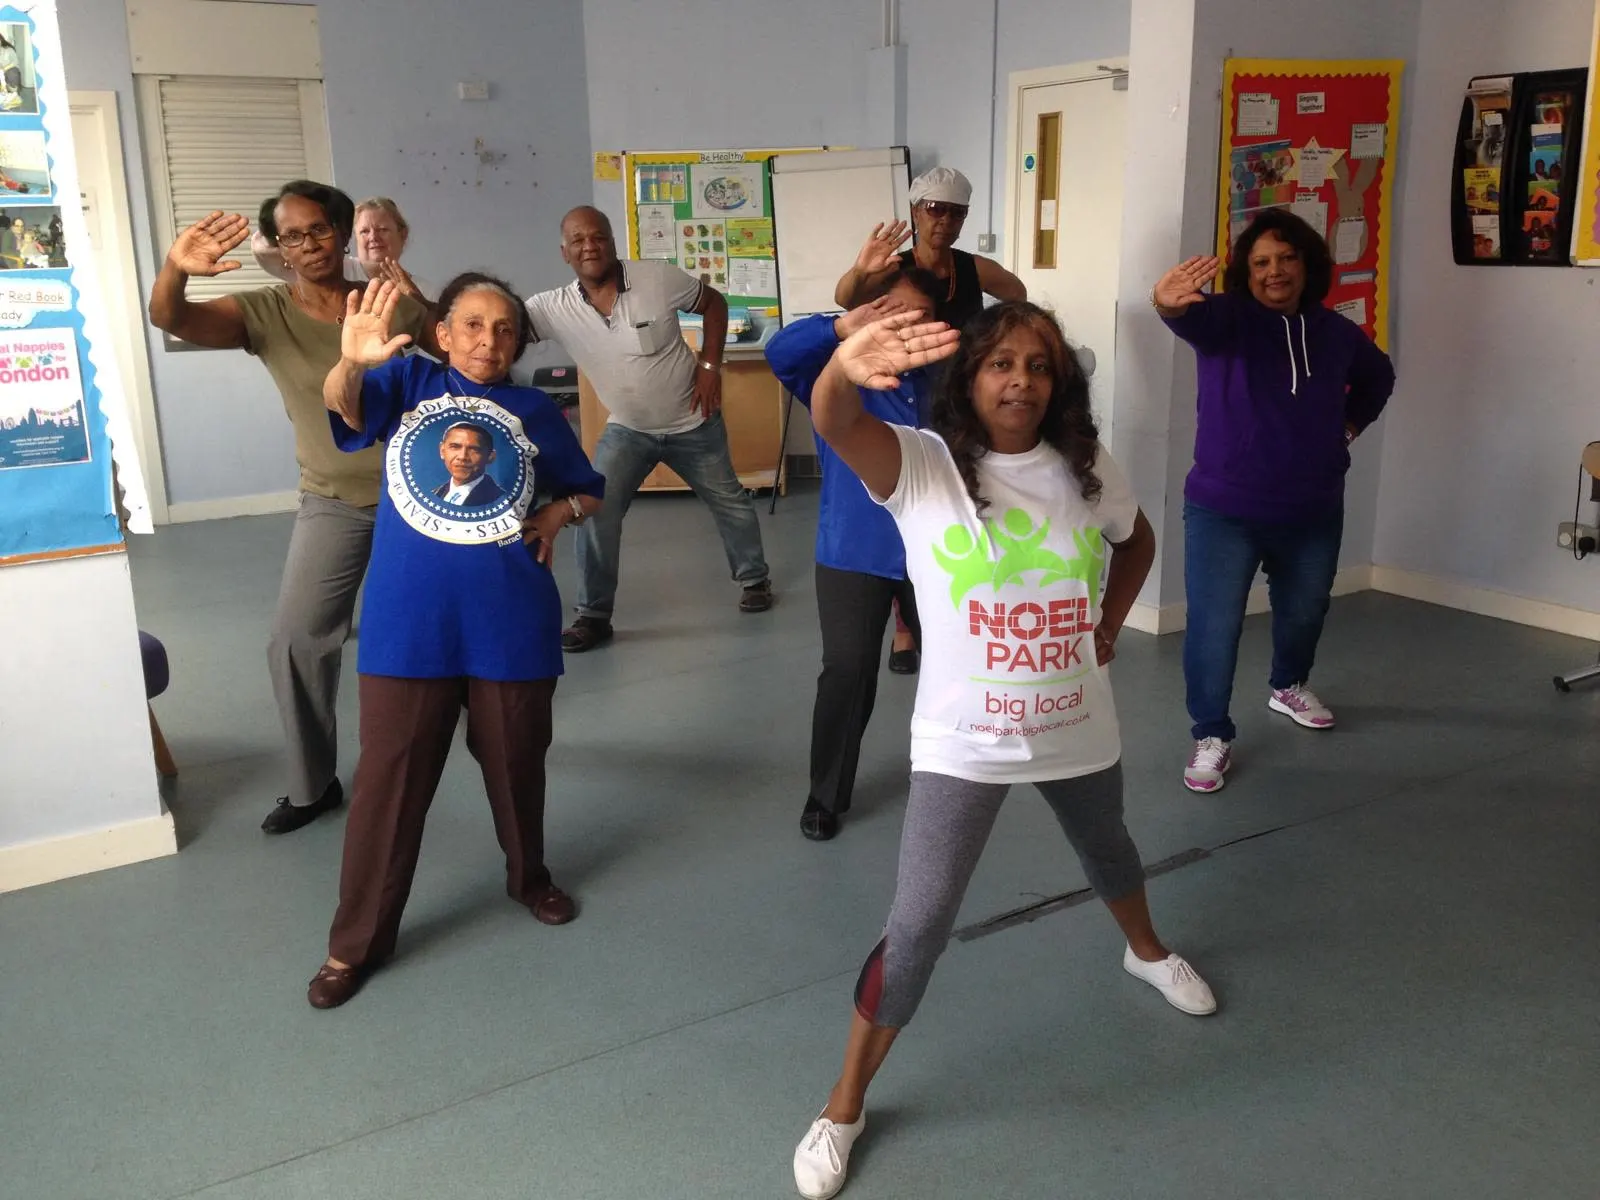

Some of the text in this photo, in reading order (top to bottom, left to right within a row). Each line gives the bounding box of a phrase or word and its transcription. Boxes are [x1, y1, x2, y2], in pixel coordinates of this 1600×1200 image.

[700, 151, 744, 162] Be Healthy
[9, 290, 31, 301] Red
[36, 290, 65, 302] Book
[0, 310, 22, 322] ady
[13, 341, 66, 355] Nappies
[403, 495, 443, 532] SEAL
[477, 403, 493, 412] OF
[495, 410, 515, 425] THE
[968, 597, 1094, 641] NOEL
[986, 636, 1083, 673] PARK
[985, 684, 1083, 722] big local
[969, 711, 1091, 738] noelparkbiglocal.co.uk
